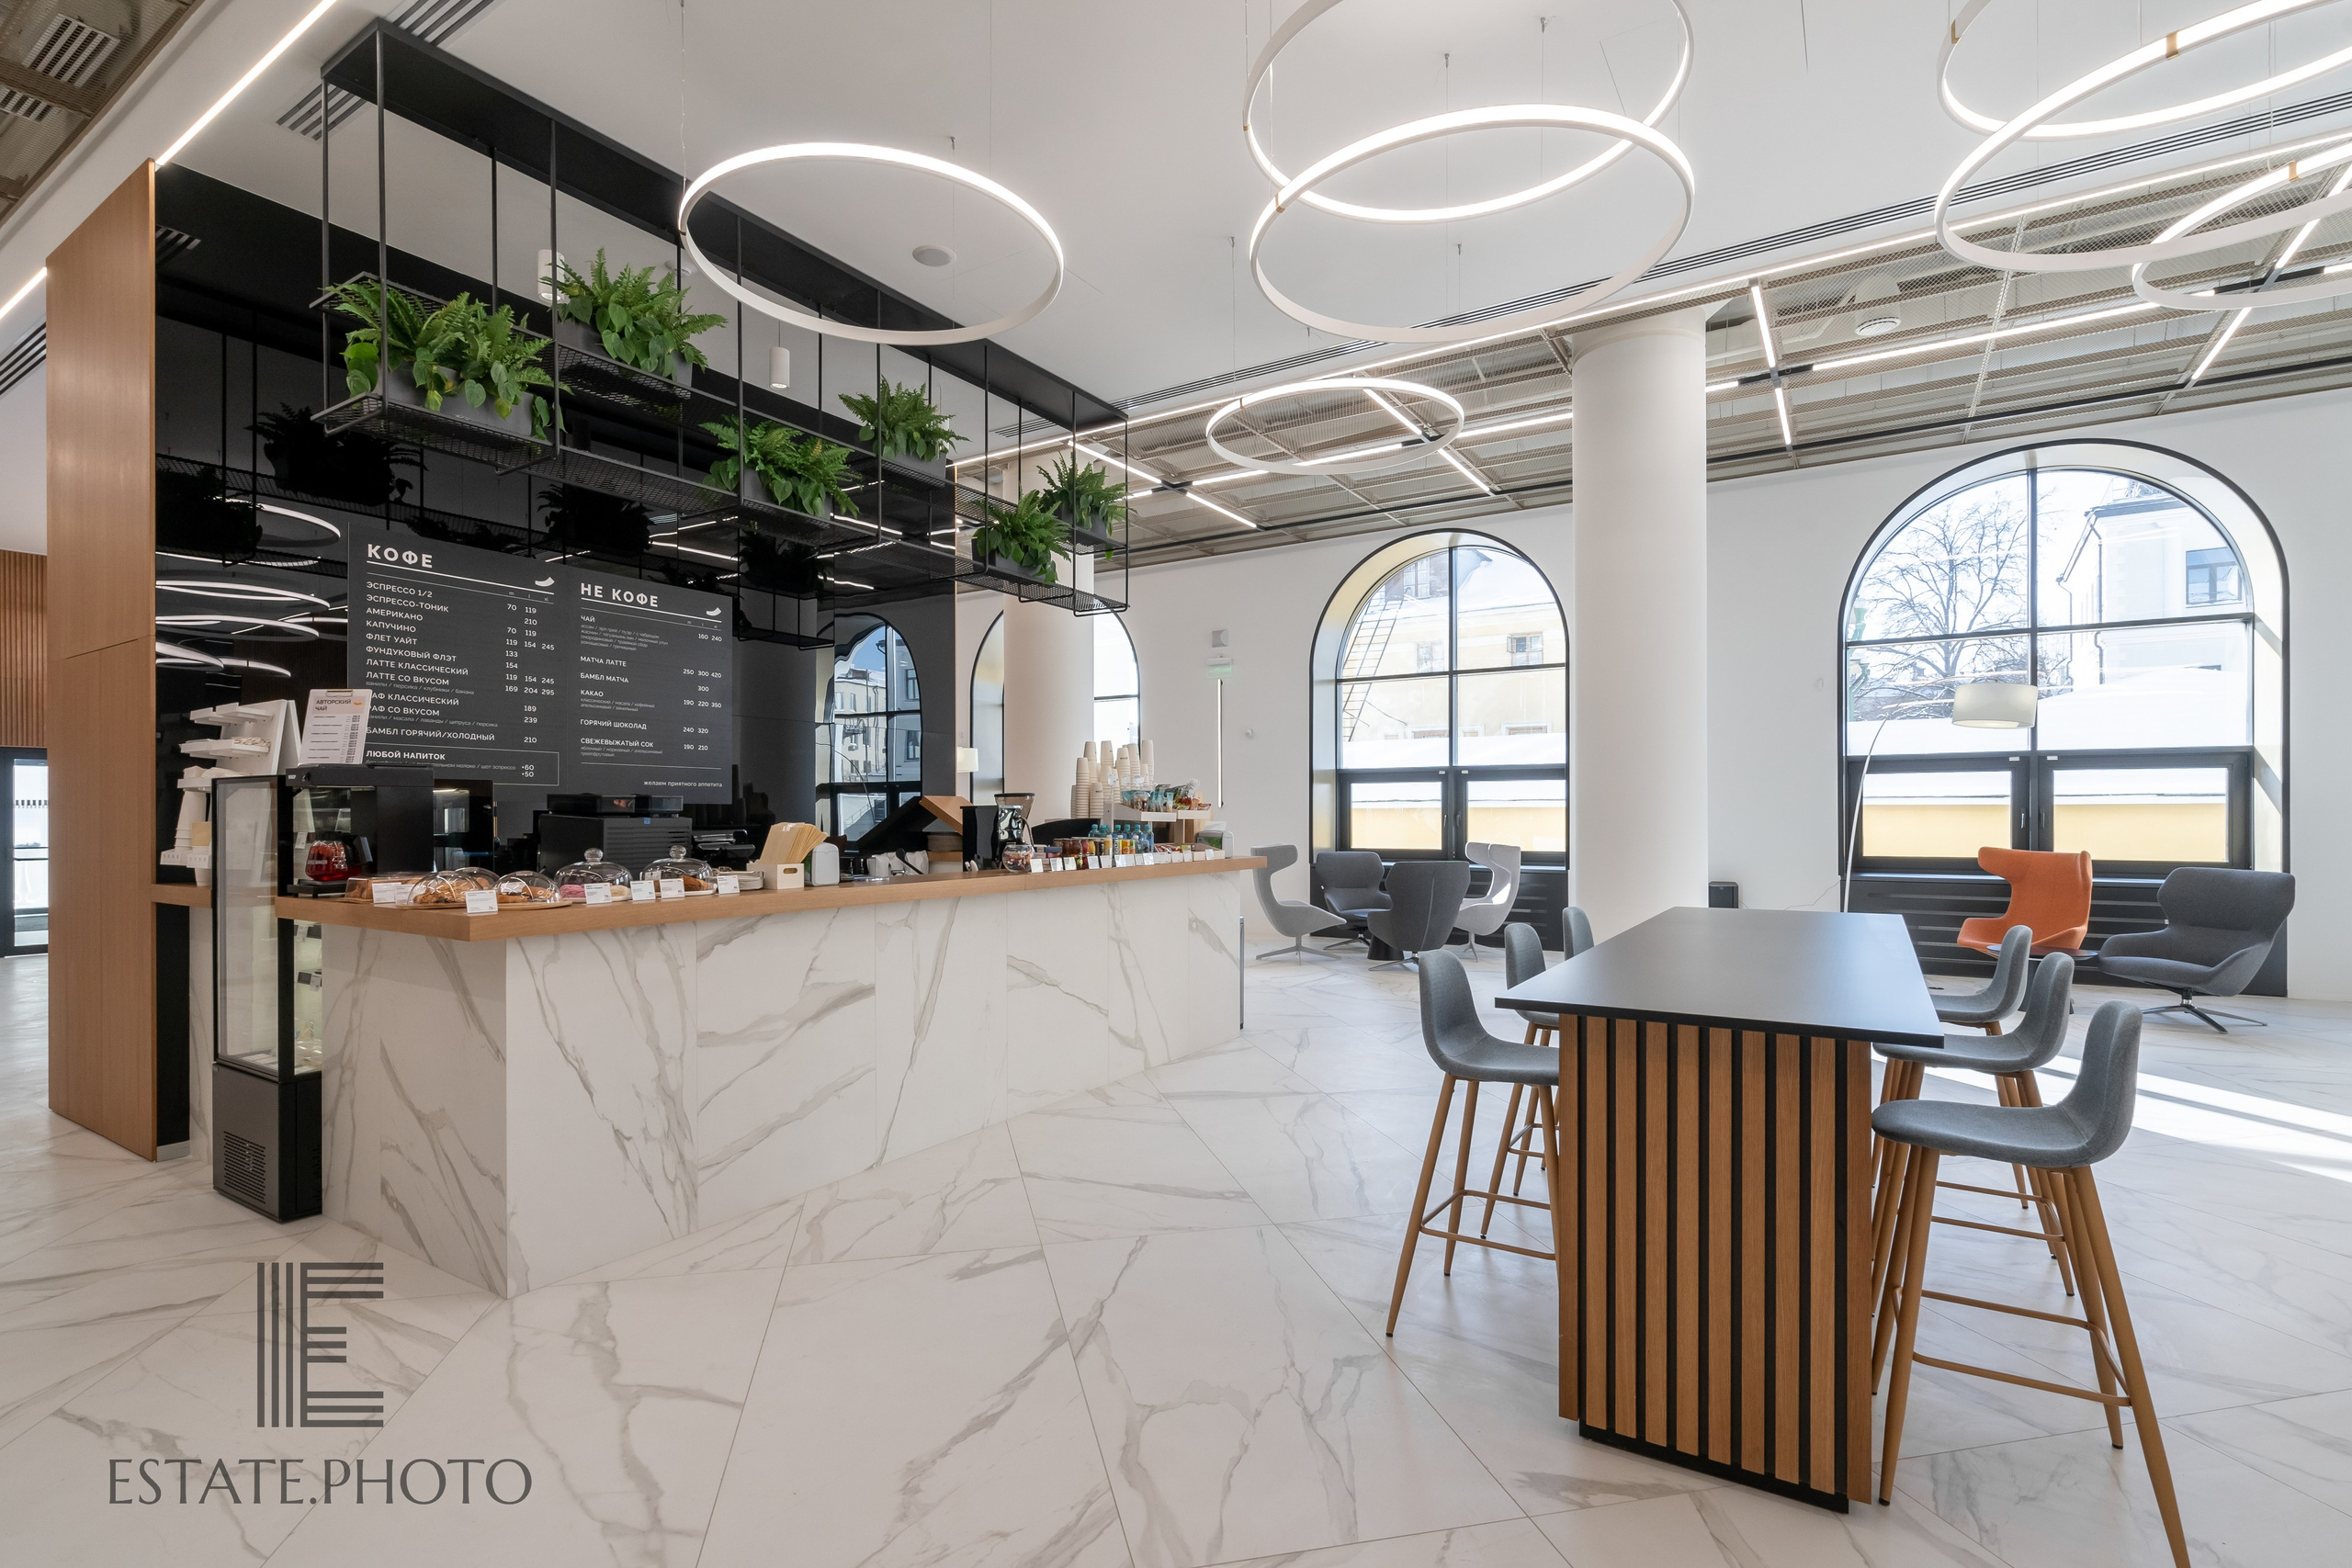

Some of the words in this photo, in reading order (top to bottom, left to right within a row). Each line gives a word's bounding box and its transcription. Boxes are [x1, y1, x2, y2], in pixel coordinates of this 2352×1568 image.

[368, 543, 433, 569] КОФЕ
[367, 581, 415, 595] ЭСПРЕССО
[418, 589, 433, 598] 1/2
[581, 582, 603, 598] НЕ
[612, 588, 658, 607] КОФЕ
[367, 594, 449, 613] ЭСПРЕССО-ТОНИК
[366, 607, 423, 621] АМЕРИКАНО
[581, 615, 595, 623] ЧАЙ
[366, 620, 416, 633] КАПУЧИНО
[366, 633, 391, 642] ФЛЕТ
[393, 636, 417, 645] УАЙТ
[366, 646, 430, 660] ФУНДУКОВЫЙ
[433, 653, 457, 661] ФЛЭТ
[580, 656, 604, 664] МАТЧА
[366, 659, 396, 669] ЛАТТЕ
[398, 662, 469, 675] КЛАССИЧЕСКИЙ
[366, 671, 396, 681] ЛАТТЕ
[413, 676, 449, 685] ВКУСОМ
[580, 672, 604, 681] БАМБЛ
[606, 675, 629, 683] МАТЧА
[388, 694, 459, 705] КЛАССИЧЕСКИЙ
[403, 707, 440, 716] ВКУСОМ
[580, 718, 612, 728] ГОРЯЧИЙ
[613, 721, 647, 730] ШОКОЛАД
[367, 727, 398, 735] БАМБЛ
[401, 728, 495, 740] ГОРЯЧИЙ/ХОЛОДНЫЙ
[581, 738, 639, 747] СВЕЖЕВЫЖАТЫЙ
[366, 750, 401, 759] ЛЮБОЙ
[403, 752, 446, 761] НАПИТОК
